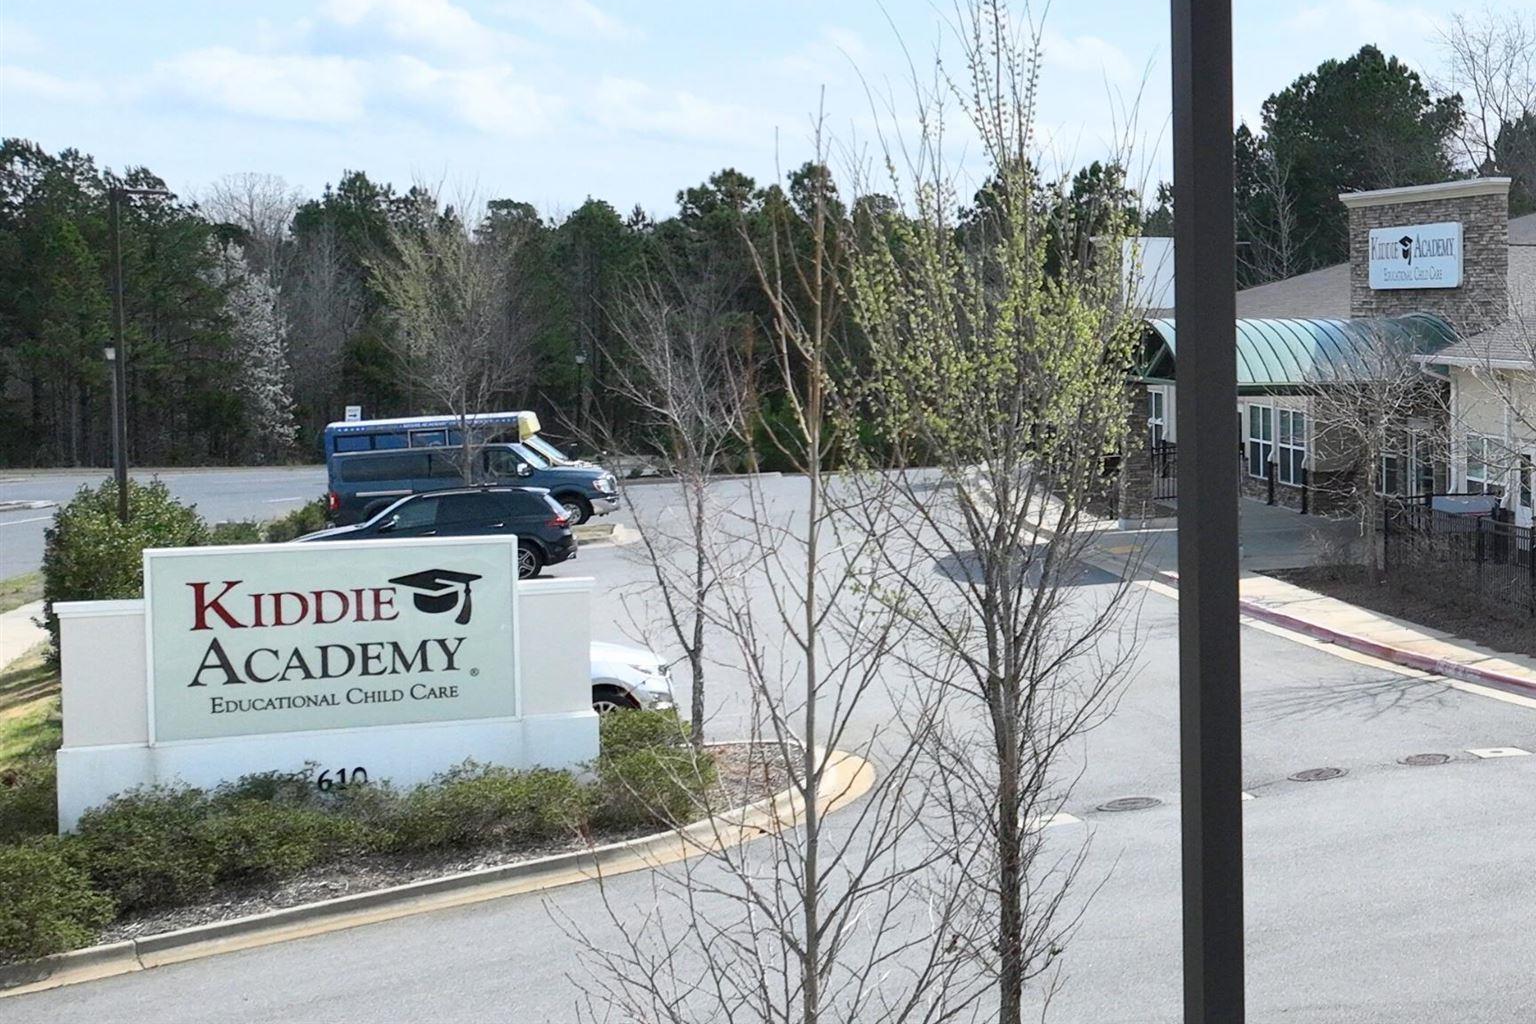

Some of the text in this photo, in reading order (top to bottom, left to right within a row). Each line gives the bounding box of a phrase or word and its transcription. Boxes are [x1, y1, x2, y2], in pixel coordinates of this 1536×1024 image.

[1414, 234, 1454, 258] ACADEMY
[185, 580, 400, 631] KIDDIE
[187, 637, 467, 687] ACADEMY
[210, 683, 459, 714] EDUCATIONAL CHILD CARE
[318, 767, 367, 792] 610
